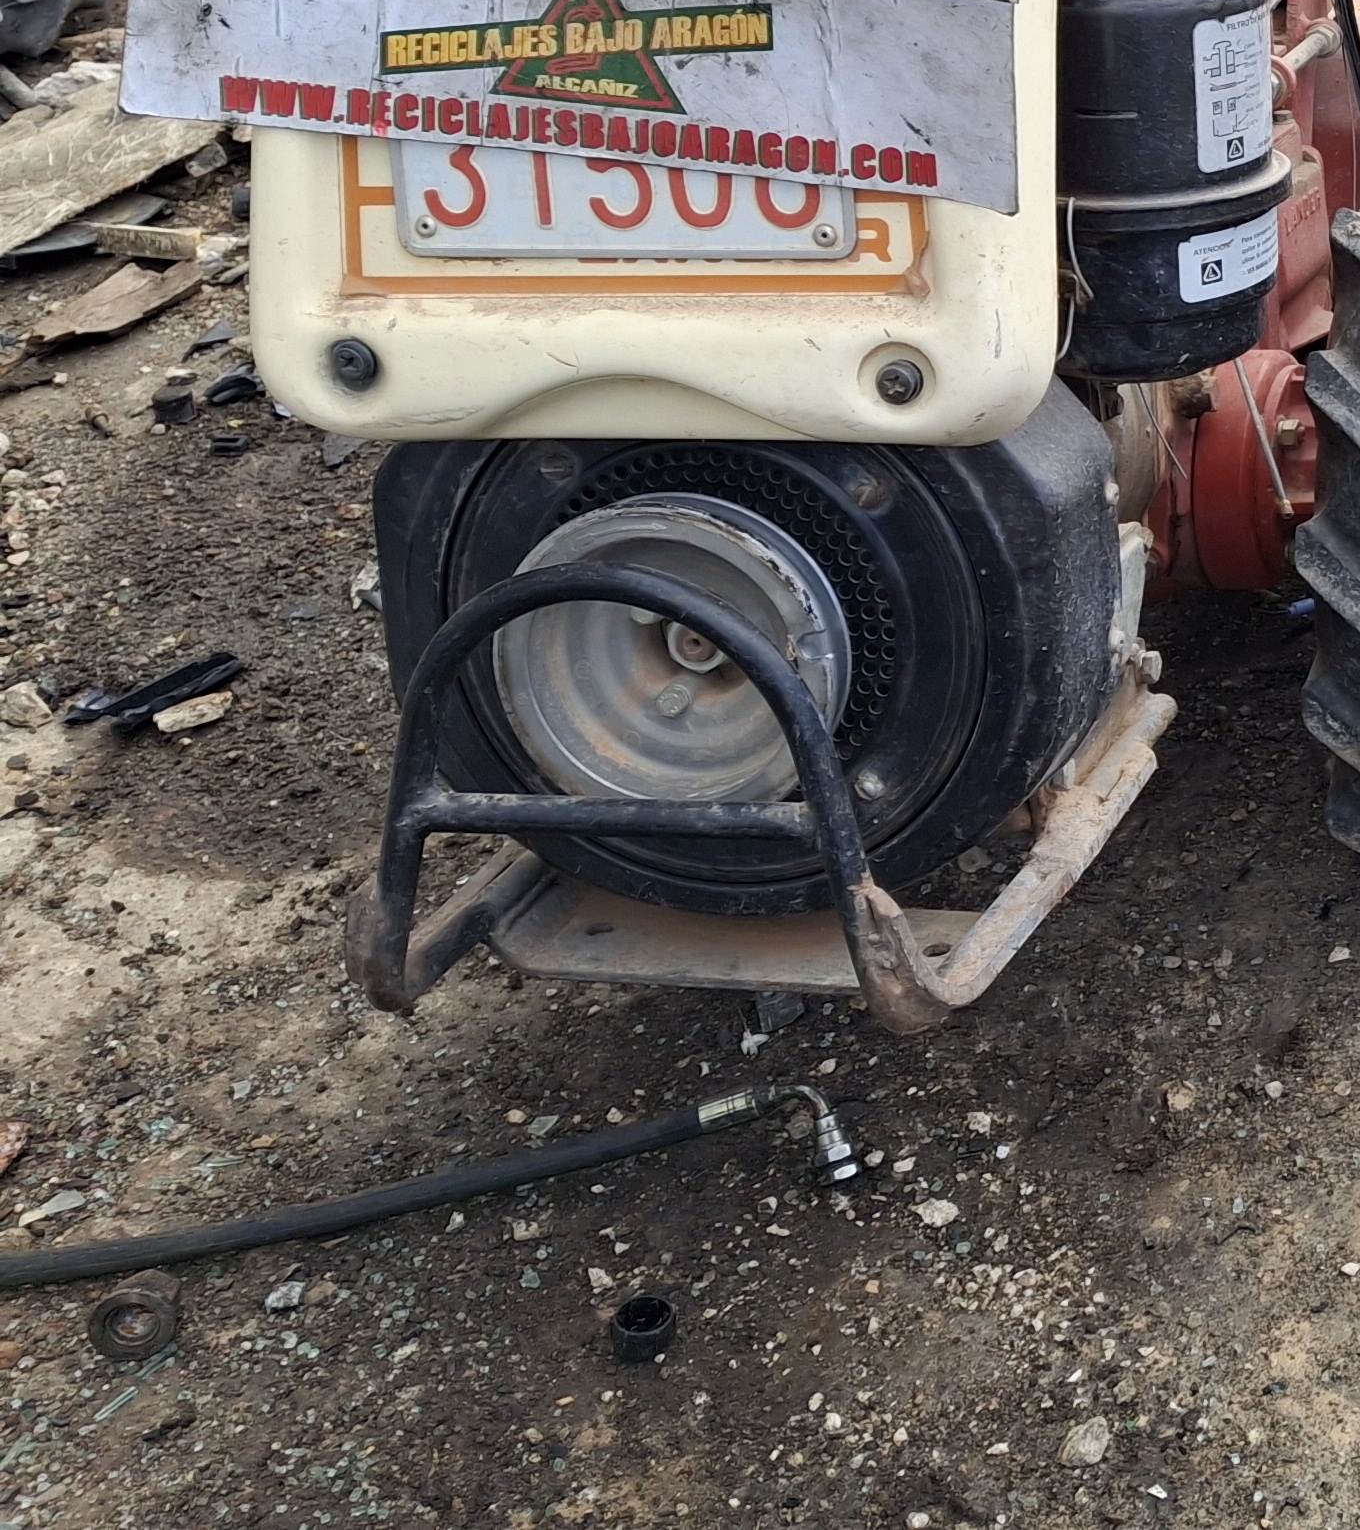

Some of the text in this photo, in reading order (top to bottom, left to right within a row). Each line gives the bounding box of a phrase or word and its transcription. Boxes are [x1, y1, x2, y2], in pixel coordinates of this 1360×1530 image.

[386, 8, 768, 68] RECICLAJES BAJO ARAGÓN
[535, 74, 638, 99] ALCAÑIZ
[219, 75, 938, 187] WWW.RECICLAJESBAJOARAGON.COM
